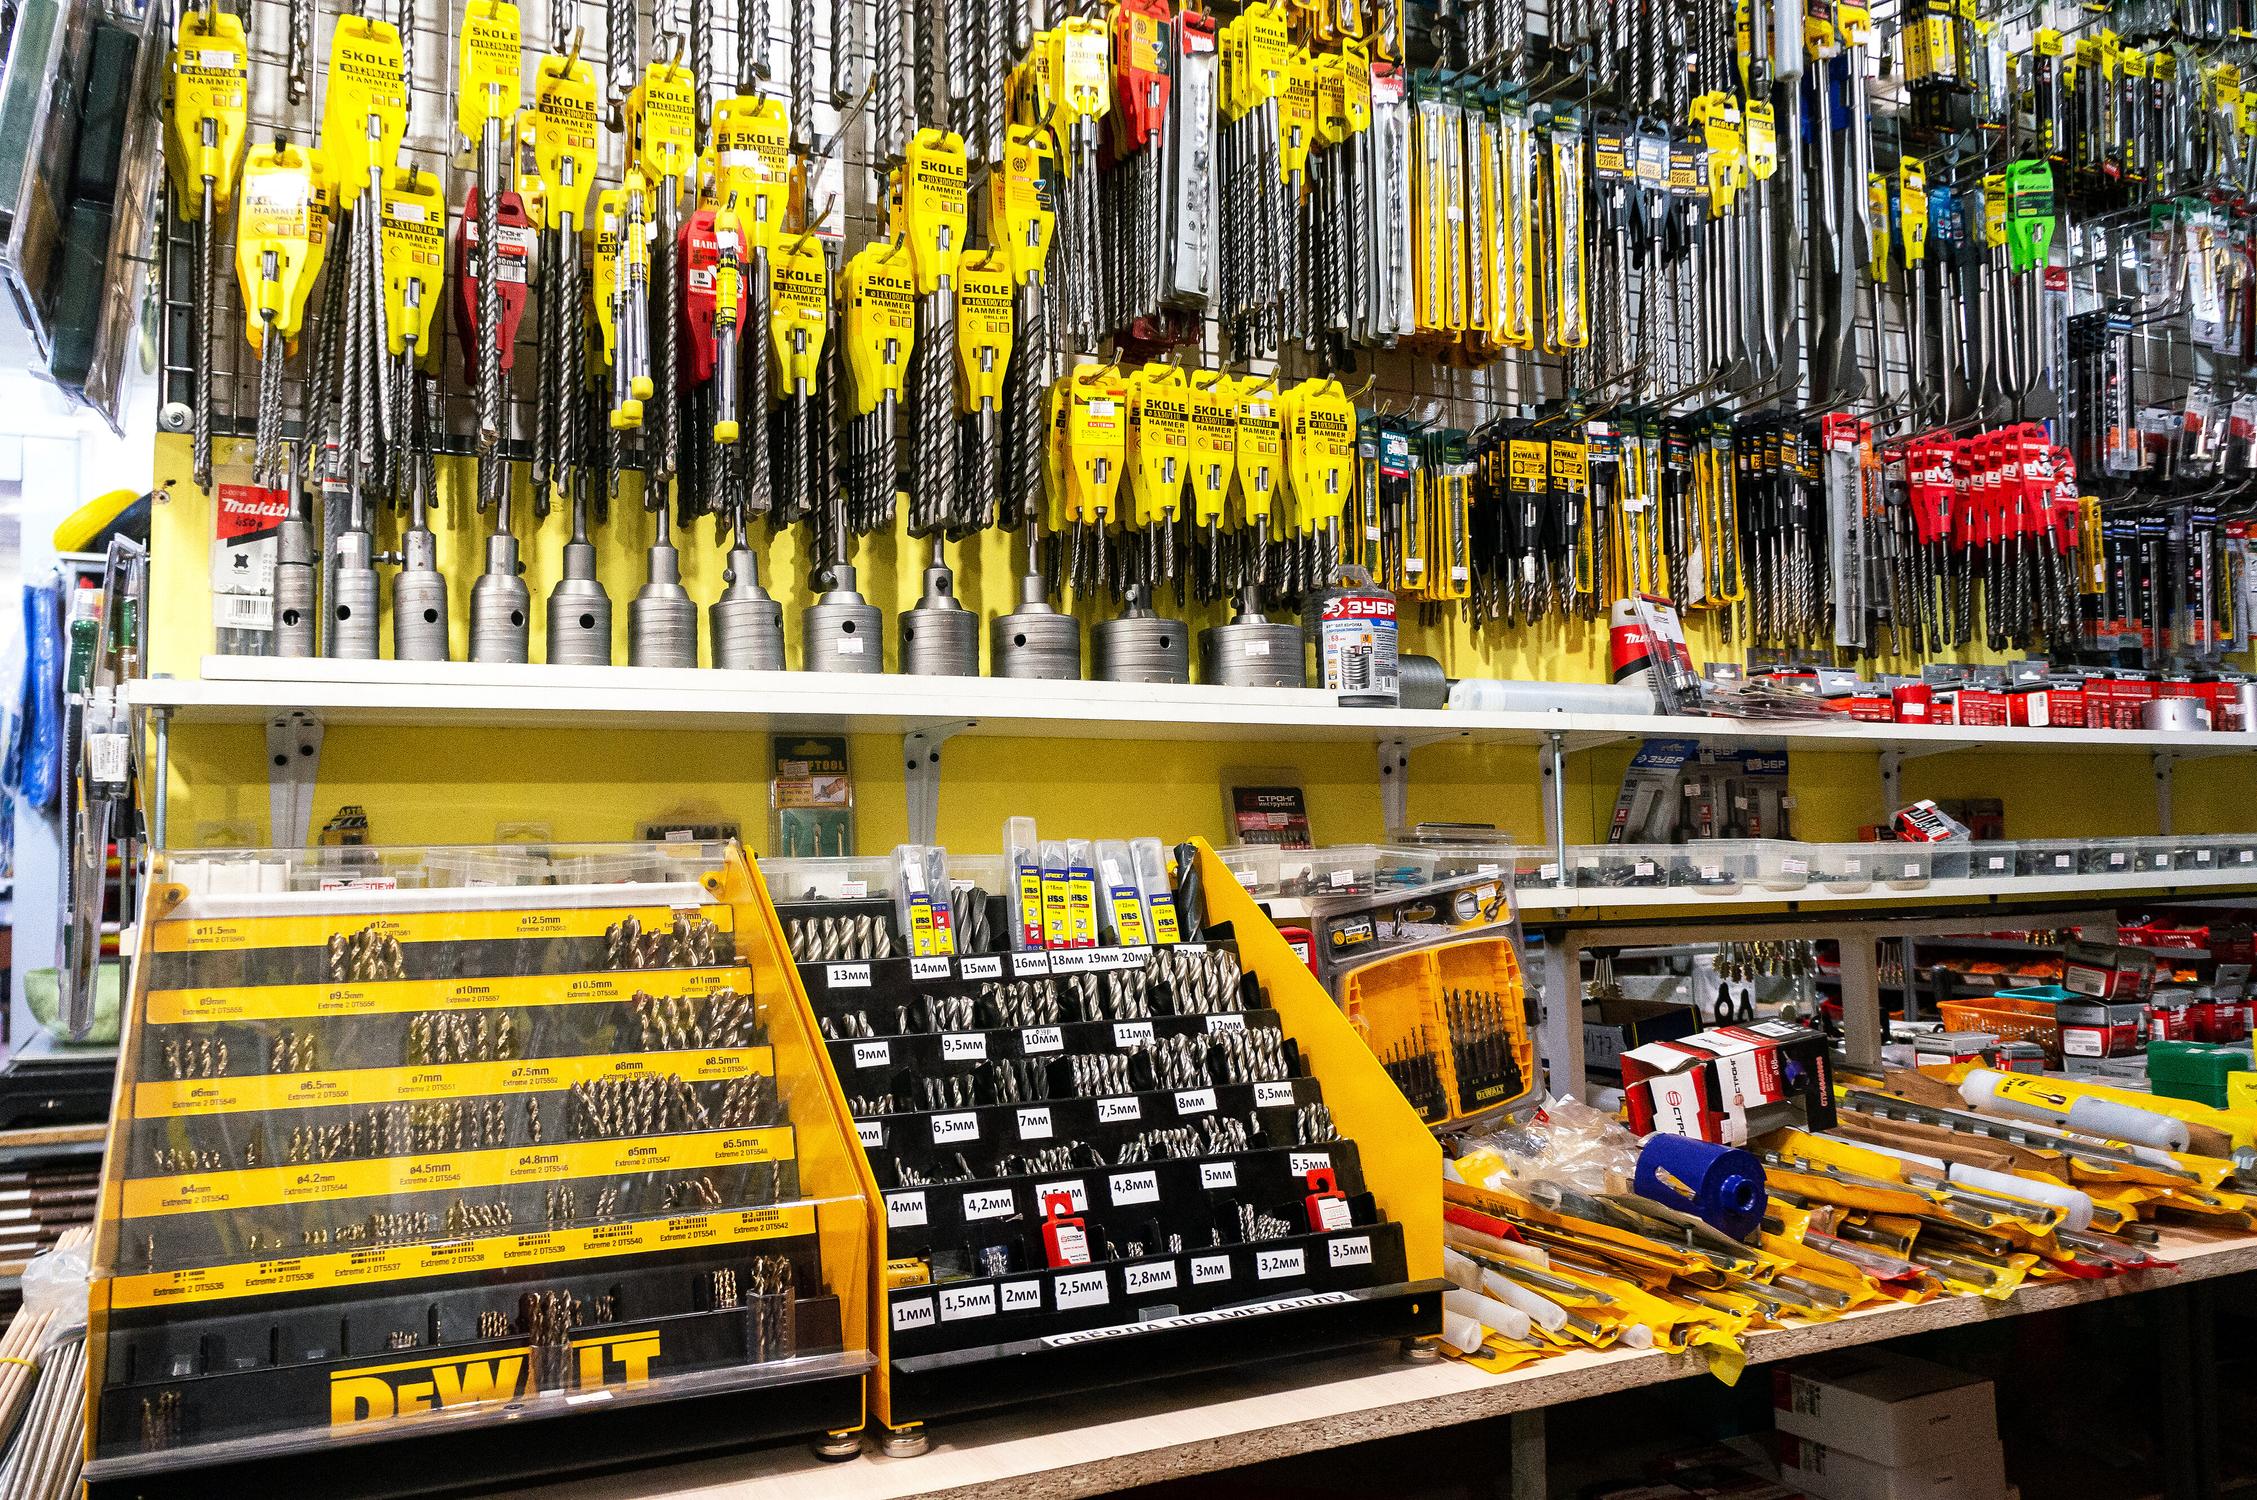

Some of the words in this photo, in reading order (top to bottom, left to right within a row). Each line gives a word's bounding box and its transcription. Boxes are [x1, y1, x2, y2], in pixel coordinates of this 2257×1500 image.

[472, 27, 518, 41] SKOLE
[1256, 26, 1285, 38] SKOLE
[342, 49, 399, 68] SKOLE
[475, 50, 518, 60] HAMMER
[1347, 61, 1367, 76] SKOLE
[188, 76, 241, 87] HAMMER
[346, 75, 399, 89] HAMMER
[542, 93, 594, 111] SKOLE
[650, 90, 690, 102] SKOLE
[652, 111, 690, 121] HAMMER
[546, 116, 592, 129] HAMMER
[737, 133, 785, 145] SKOLE
[921, 160, 964, 176] SKOLE
[924, 184, 962, 196] HAMMER
[388, 230, 438, 244] HAMMER
[776, 268, 822, 282] SKOLE
[868, 275, 912, 290] SKOLE
[964, 284, 1008, 294] SKOLE
[780, 292, 821, 302] HAMMER
[872, 299, 910, 310] HAMMER
[1146, 400, 1185, 412] SKOLE
[1194, 405, 1232, 418] SKOLE
[1311, 411, 1344, 422] SKOLE
[1150, 419, 1184, 428] HAMMER
[1197, 424, 1232, 434] HAMMER
[1243, 427, 1276, 436] HAMMER
[1314, 430, 1346, 438] HAMMER
[1348, 601, 1394, 616] ЗУБР
[1648, 756, 1684, 764] ЗУБР
[1362, 926, 1370, 938] 2
[1730, 1058, 1740, 1094] СТРОНГ
[284, 1188, 313, 1196] Extreme
[734, 1225, 758, 1234] Extreme
[765, 1222, 788, 1230] DT5542
[660, 1233, 686, 1242] Extreme
[694, 1230, 716, 1238] DT5541
[584, 1240, 611, 1249] Extreme
[618, 1237, 642, 1246] DT5540
[504, 1250, 532, 1258] Extreme
[540, 1246, 566, 1254] DT5539
[421, 1258, 449, 1268] Extreme
[458, 1254, 484, 1262] DT5538
[335, 1268, 364, 1276] Extreme
[374, 1264, 401, 1272] DT5537
[1170, 1315, 1216, 1328] ПО
[1217, 1294, 1347, 1321] МЕТАЛЛУ
